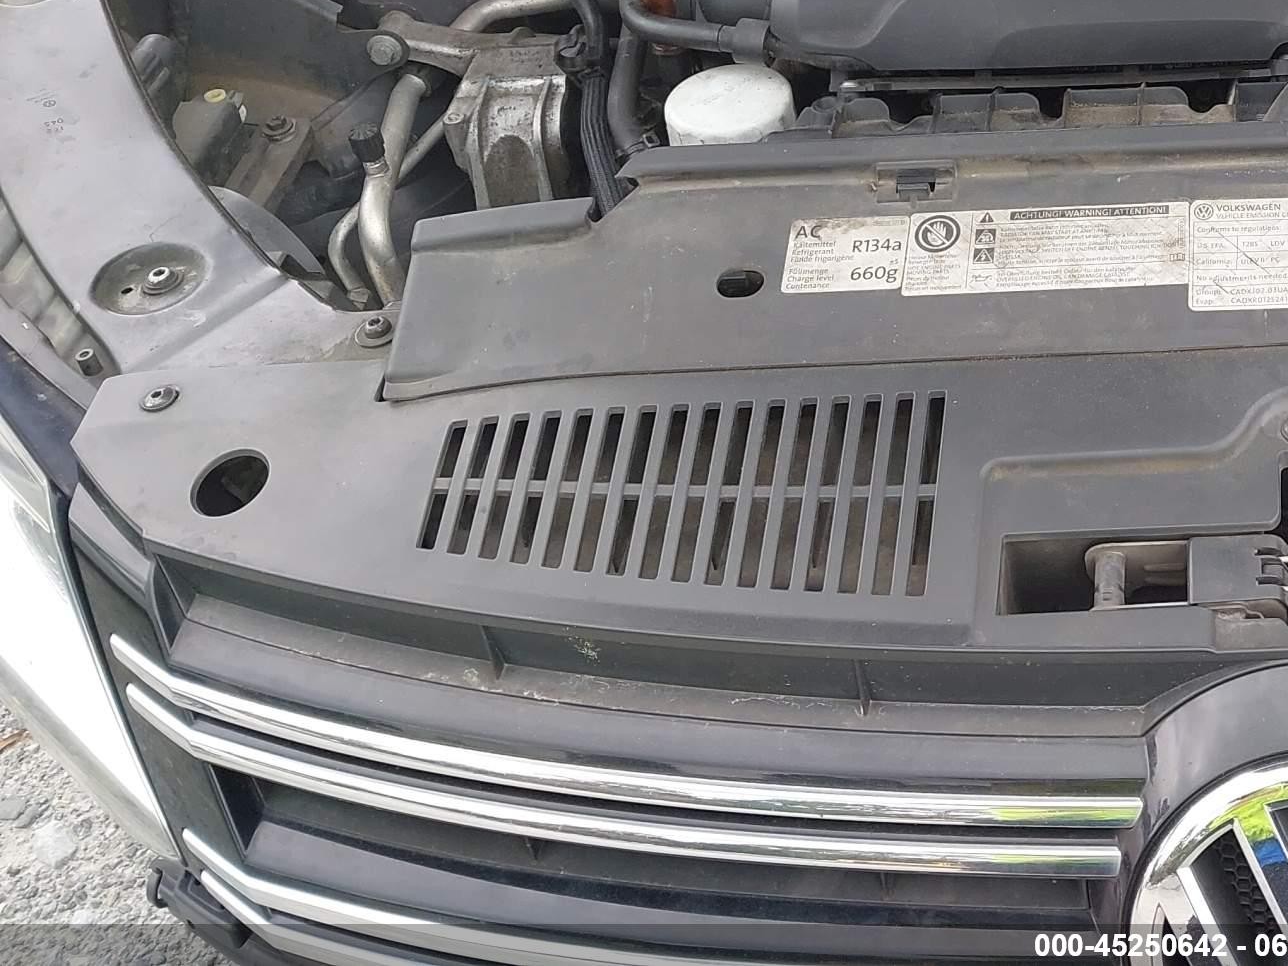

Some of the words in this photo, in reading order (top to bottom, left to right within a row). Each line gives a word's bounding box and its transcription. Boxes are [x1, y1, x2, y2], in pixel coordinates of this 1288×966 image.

[1014, 211, 1061, 219] ACHTUNG!
[1064, 208, 1111, 218] WARNING!
[1114, 206, 1166, 216] ATTENTION!
[1216, 204, 1280, 212] VOLKSWAGEN
[794, 225, 821, 239] AC
[852, 238, 902, 252] R134a
[792, 249, 834, 257] Refrigerant
[787, 275, 814, 283] Charge
[850, 266, 899, 284] 660g
